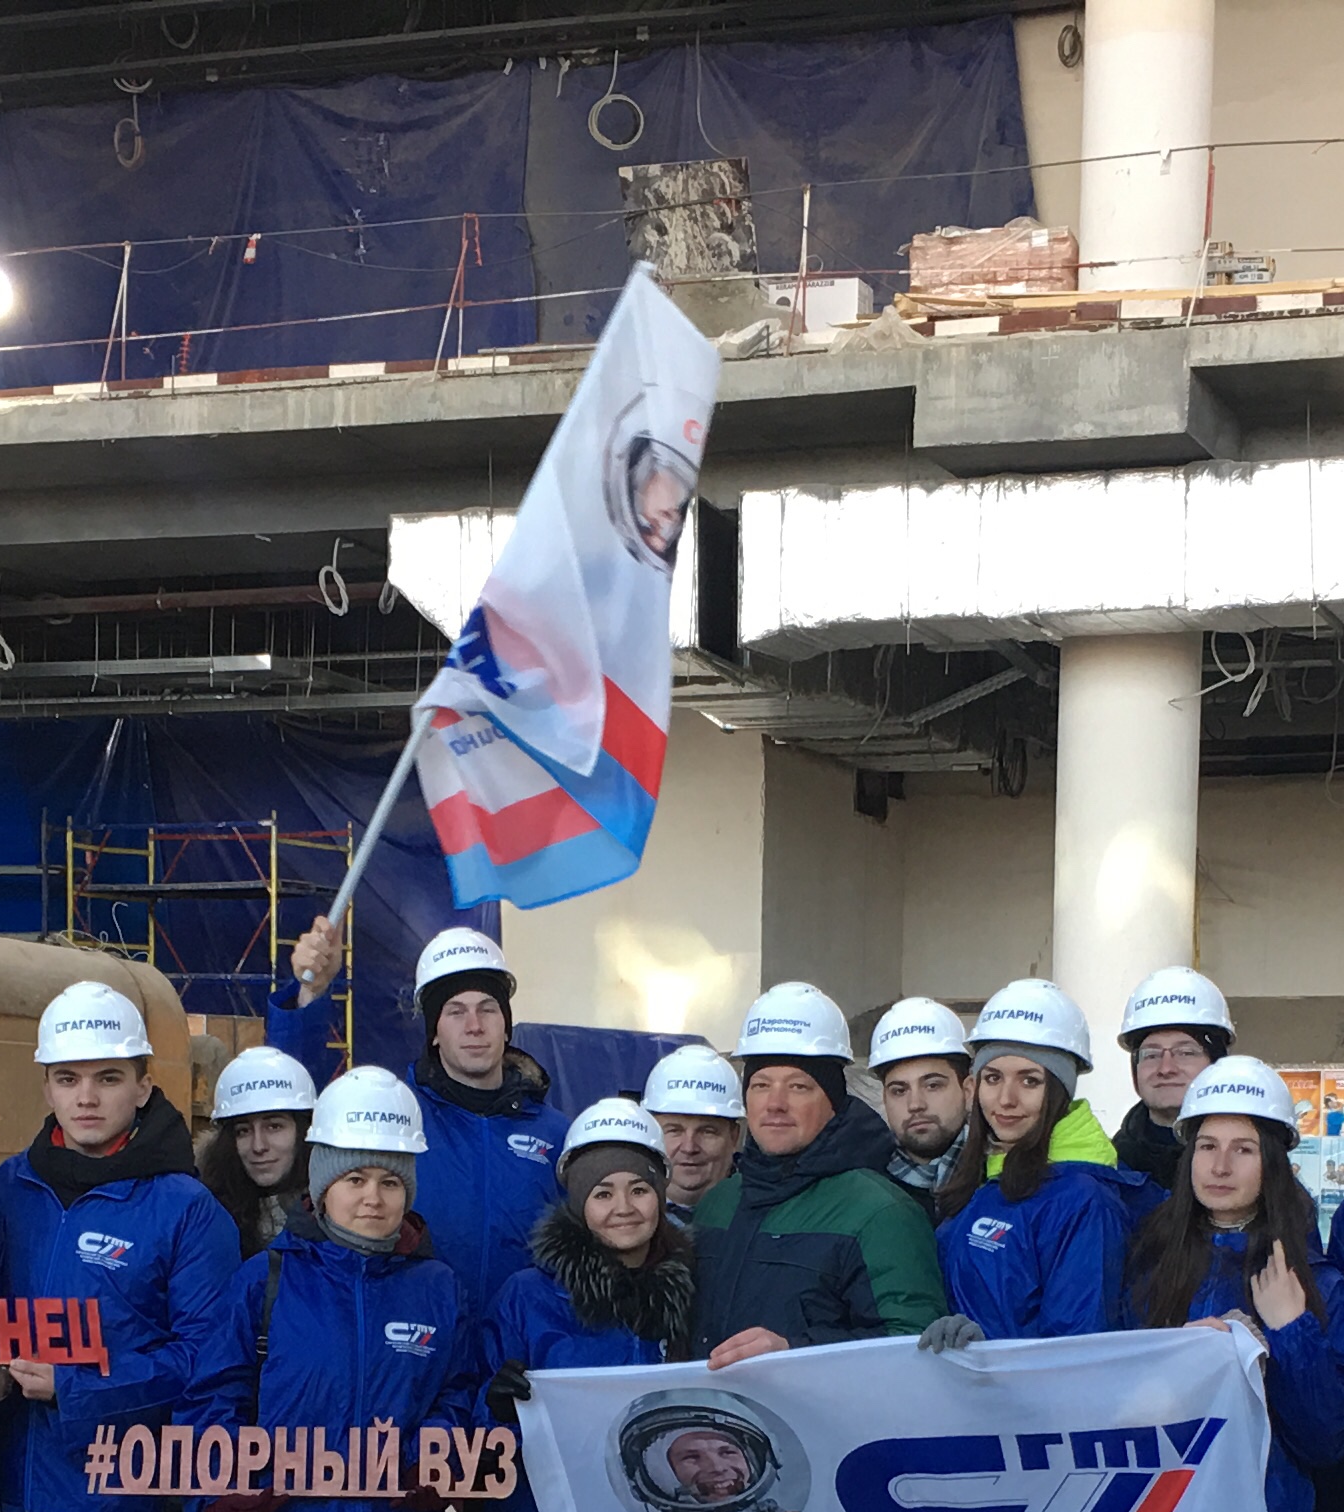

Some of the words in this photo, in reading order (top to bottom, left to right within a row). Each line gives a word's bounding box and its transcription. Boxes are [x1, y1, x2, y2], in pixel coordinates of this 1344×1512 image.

[438, 946, 488, 959] ГАГАРИН
[1141, 995, 1196, 1007] ГАГАРИН
[988, 1009, 1044, 1023] ГАГАРИН
[64, 1019, 121, 1031] ГАГАРИН
[886, 1025, 935, 1040] ГАГАРИН
[239, 1080, 293, 1094] ГАГАРИН
[676, 1080, 727, 1094] ГАГАРИН
[1205, 1084, 1265, 1098] ГАГАРИН
[357, 1111, 412, 1126] ГАГАРИН
[593, 1118, 648, 1133] ГАГАРИН
[84, 1416, 401, 1498] #ОПОРНЫЙ
[418, 1426, 518, 1499] ВУЗ
